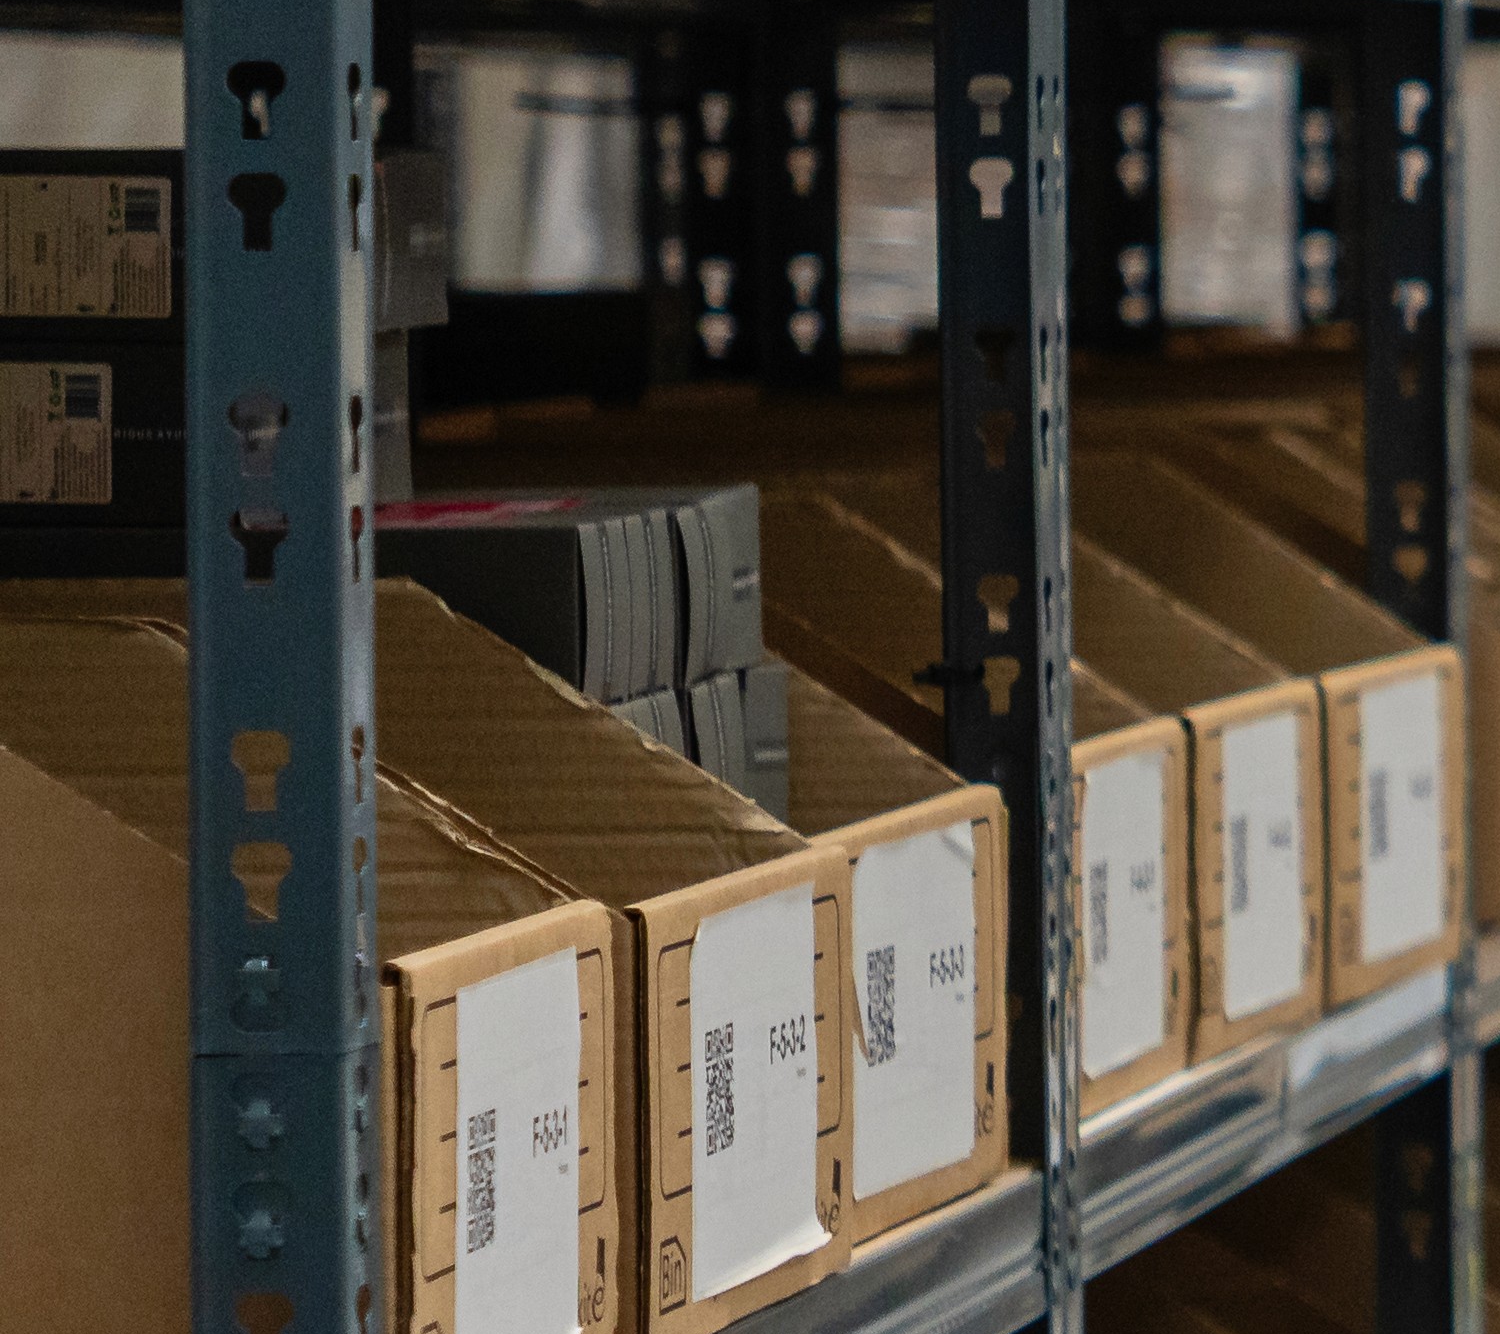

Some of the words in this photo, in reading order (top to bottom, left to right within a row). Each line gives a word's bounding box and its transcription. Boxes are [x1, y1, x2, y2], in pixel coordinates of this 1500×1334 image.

[930, 944, 964, 988] F-5-3-3
[770, 1014, 806, 1065] F-5-3-2
[533, 1105, 568, 1158] F-5-3-1
[662, 1251, 683, 1299] Bin
